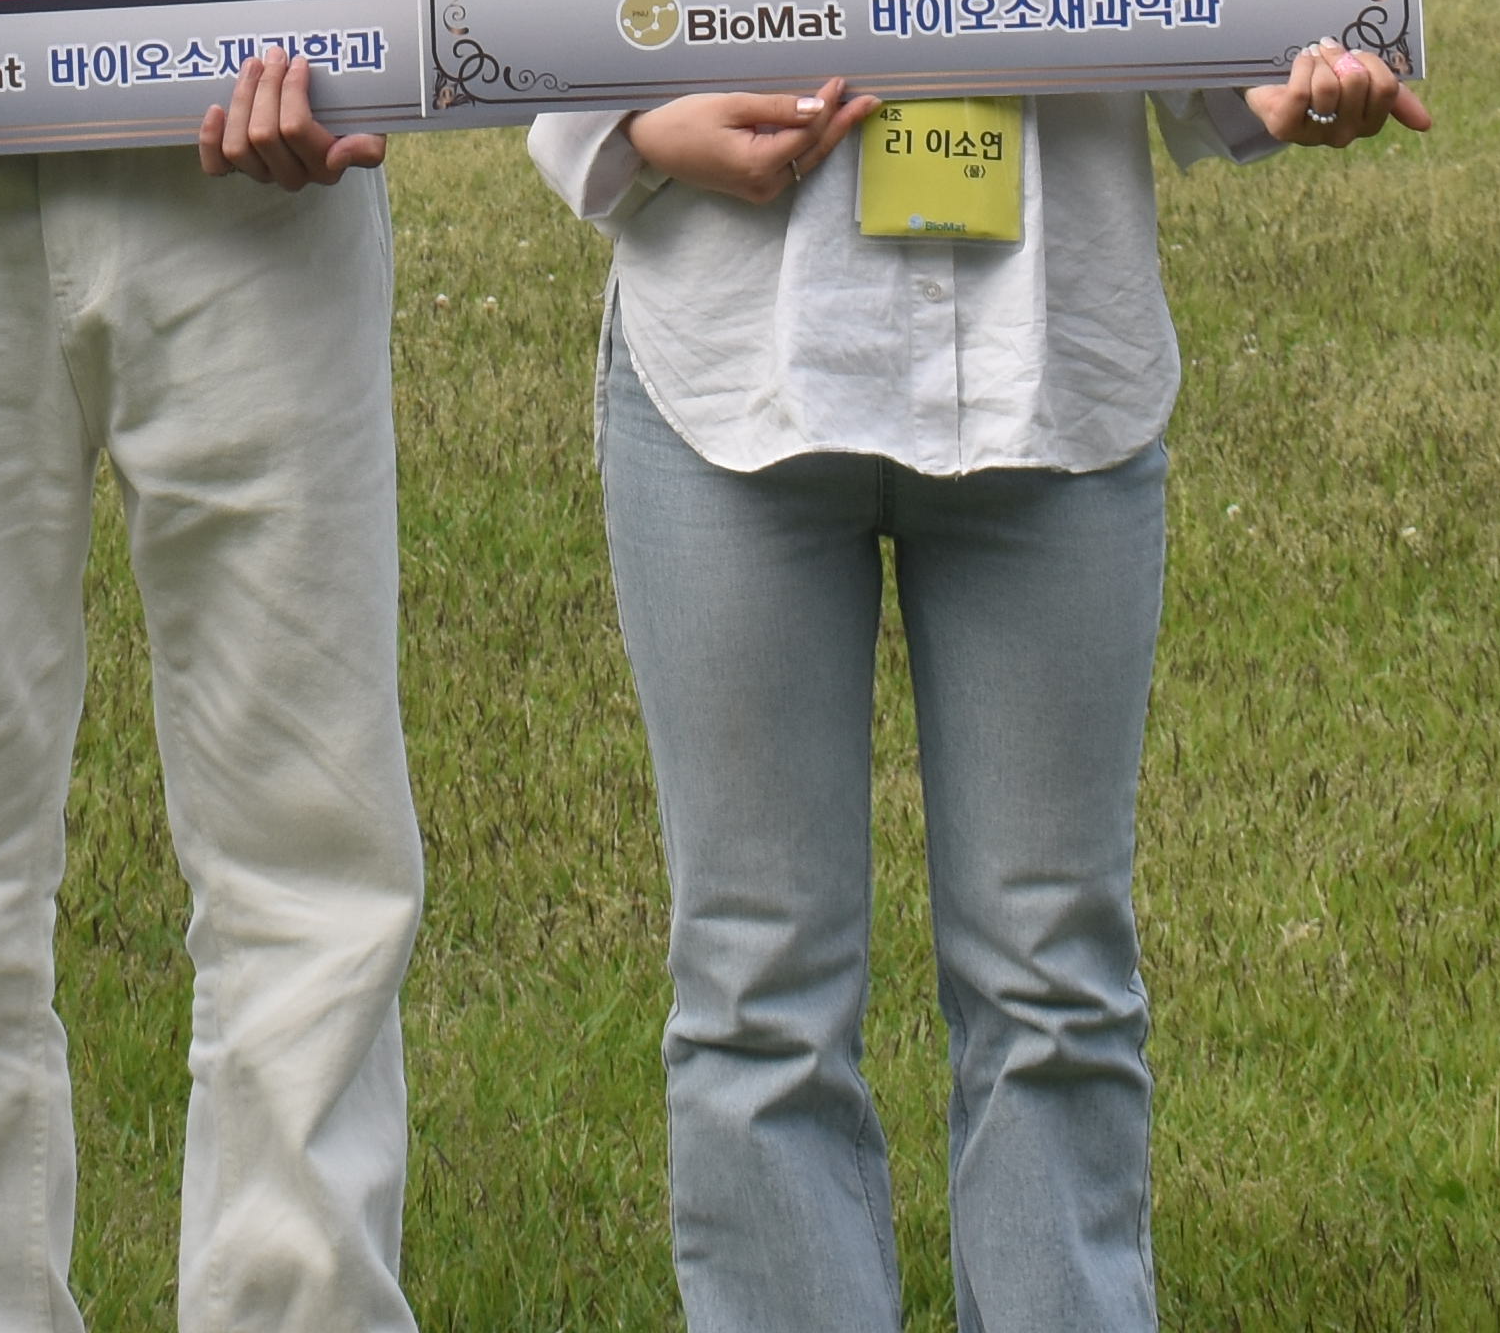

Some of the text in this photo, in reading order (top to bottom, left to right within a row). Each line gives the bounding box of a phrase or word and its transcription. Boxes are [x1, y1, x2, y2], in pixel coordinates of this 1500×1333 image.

[687, 5, 842, 45] BioMat
[880, 108, 903, 122] 4조
[885, 129, 1003, 161] 리 이소연
